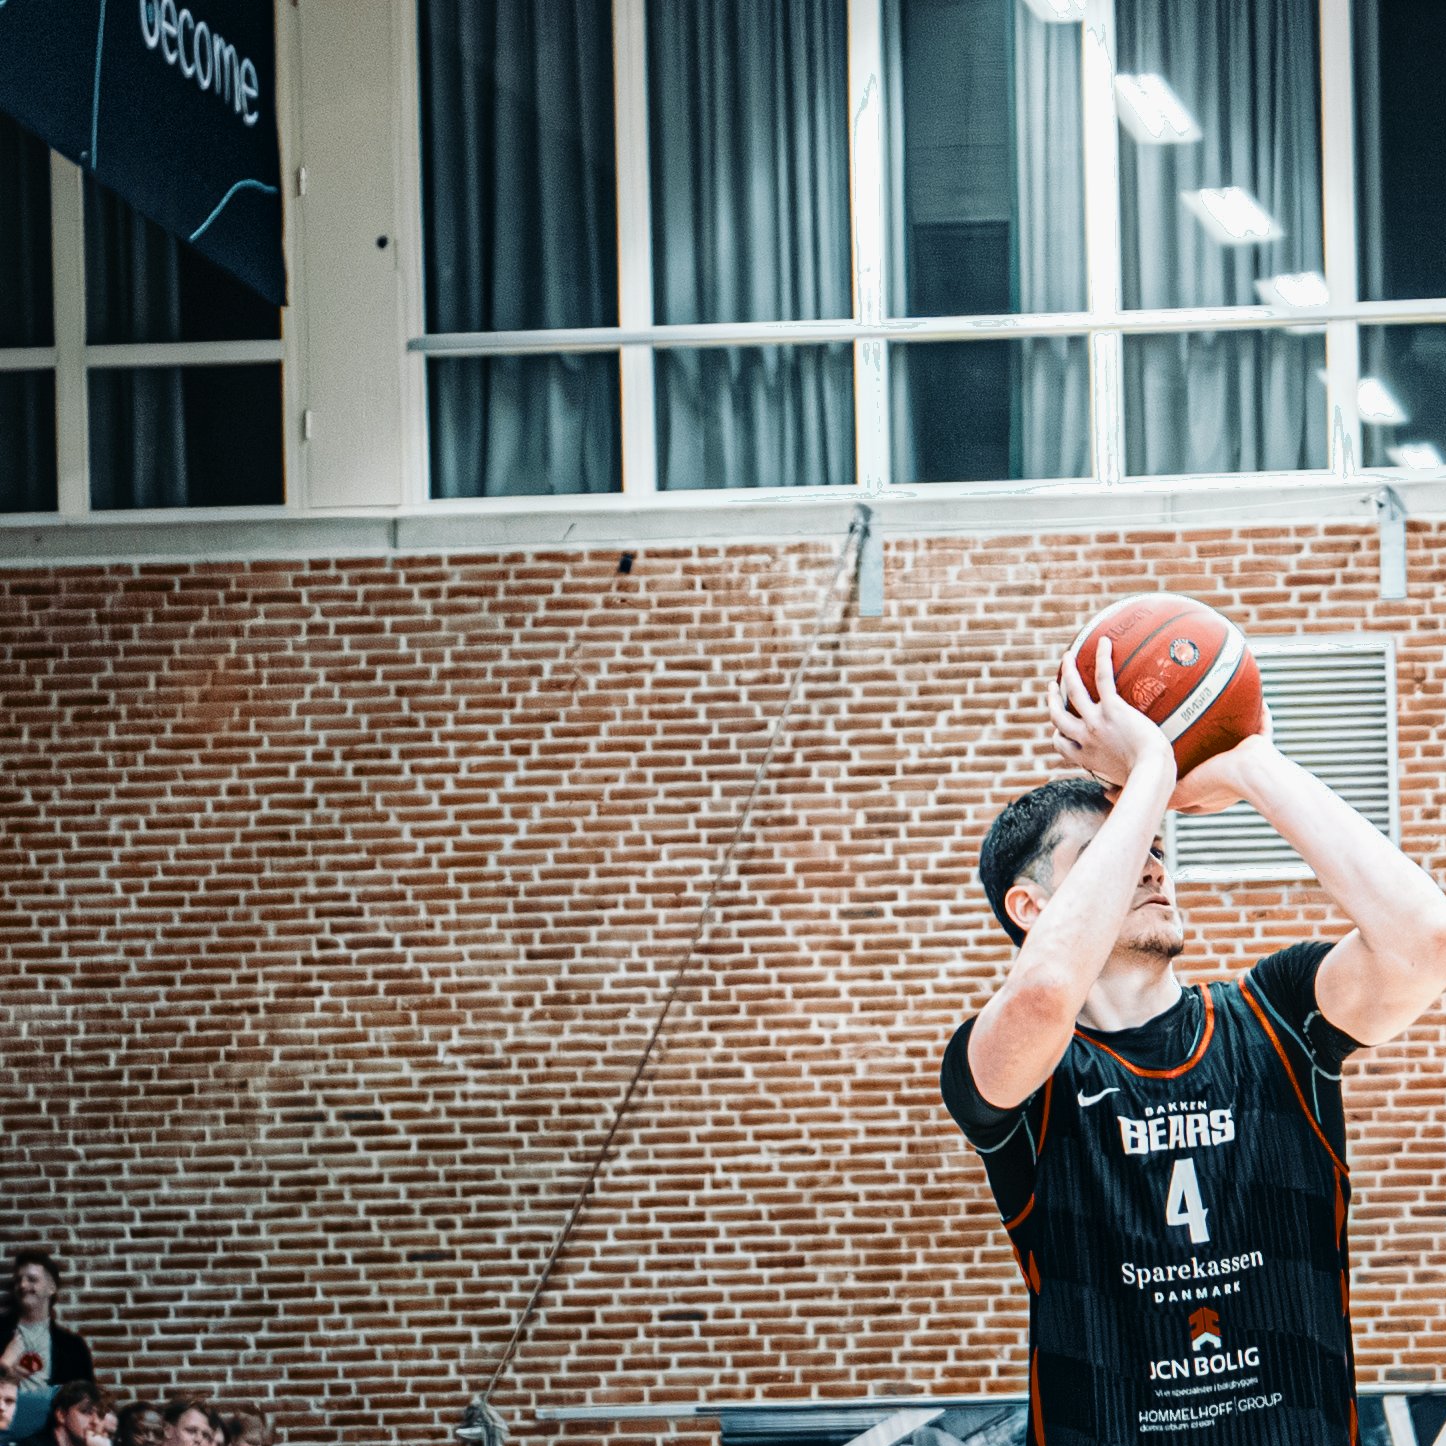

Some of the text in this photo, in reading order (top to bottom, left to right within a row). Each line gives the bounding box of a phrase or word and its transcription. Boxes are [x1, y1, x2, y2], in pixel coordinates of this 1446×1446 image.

[1145, 1100, 1207, 1117] BAKKEN
[1117, 1108, 1235, 1155] BEARS
[1165, 1157, 1210, 1245] 4
[1121, 1249, 1264, 1290] Sparekassen
[1154, 1281, 1241, 1304] DANMARK
[1150, 1347, 1260, 1381] JCN BOLIG
[1138, 1392, 1283, 1423] HOMMELHOFF GROUP
